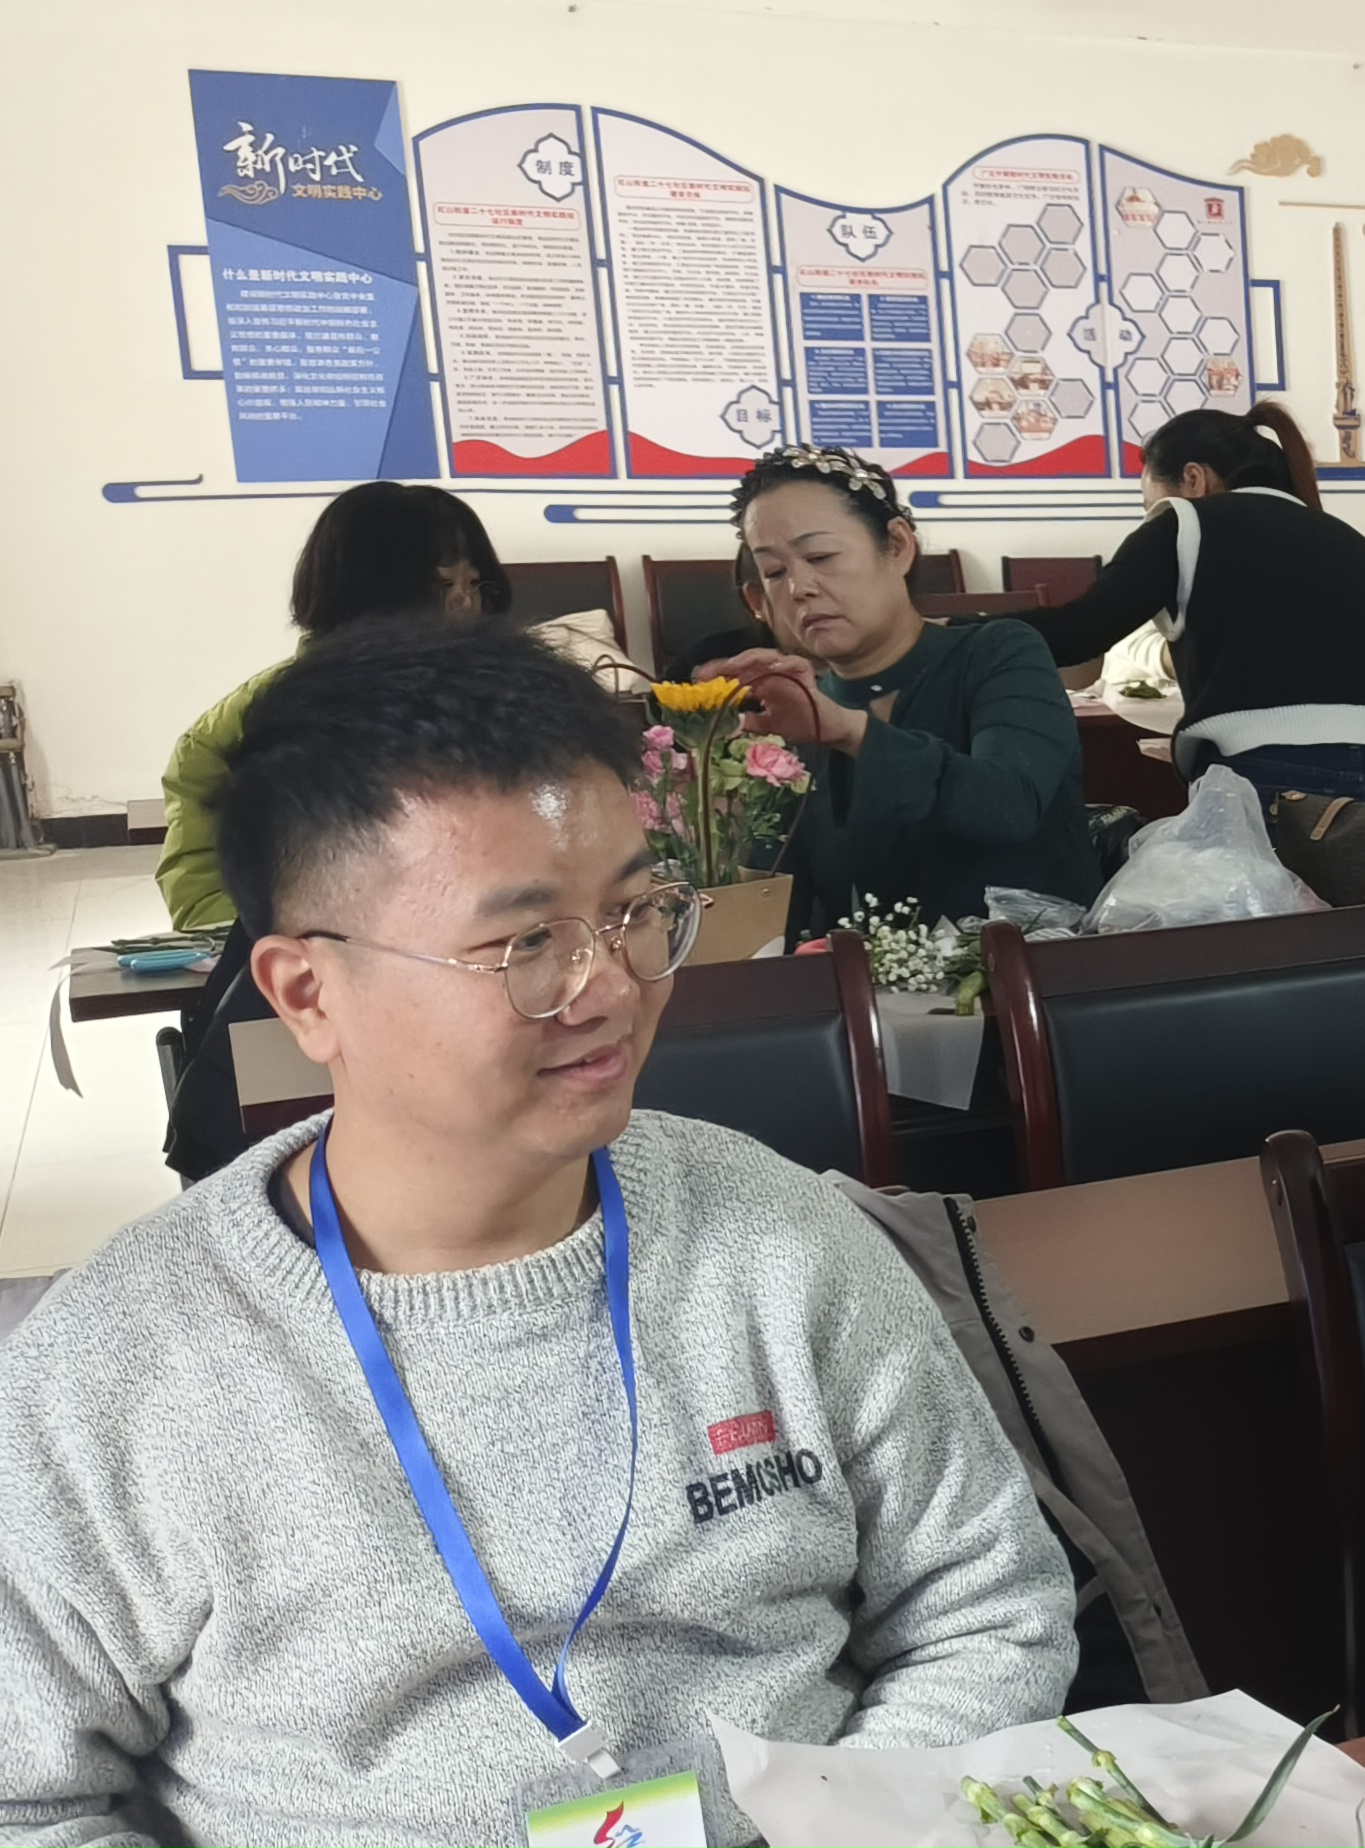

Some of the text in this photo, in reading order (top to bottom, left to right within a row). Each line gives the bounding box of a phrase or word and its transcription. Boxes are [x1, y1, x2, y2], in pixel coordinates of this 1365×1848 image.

[223, 121, 365, 195] 新时代
[535, 159, 576, 177] 制度
[291, 183, 383, 201] 文明实践中心
[840, 223, 879, 240] 队伍
[222, 267, 373, 285] 什么是新时代文明实践中心
[734, 406, 773, 425] 目标
